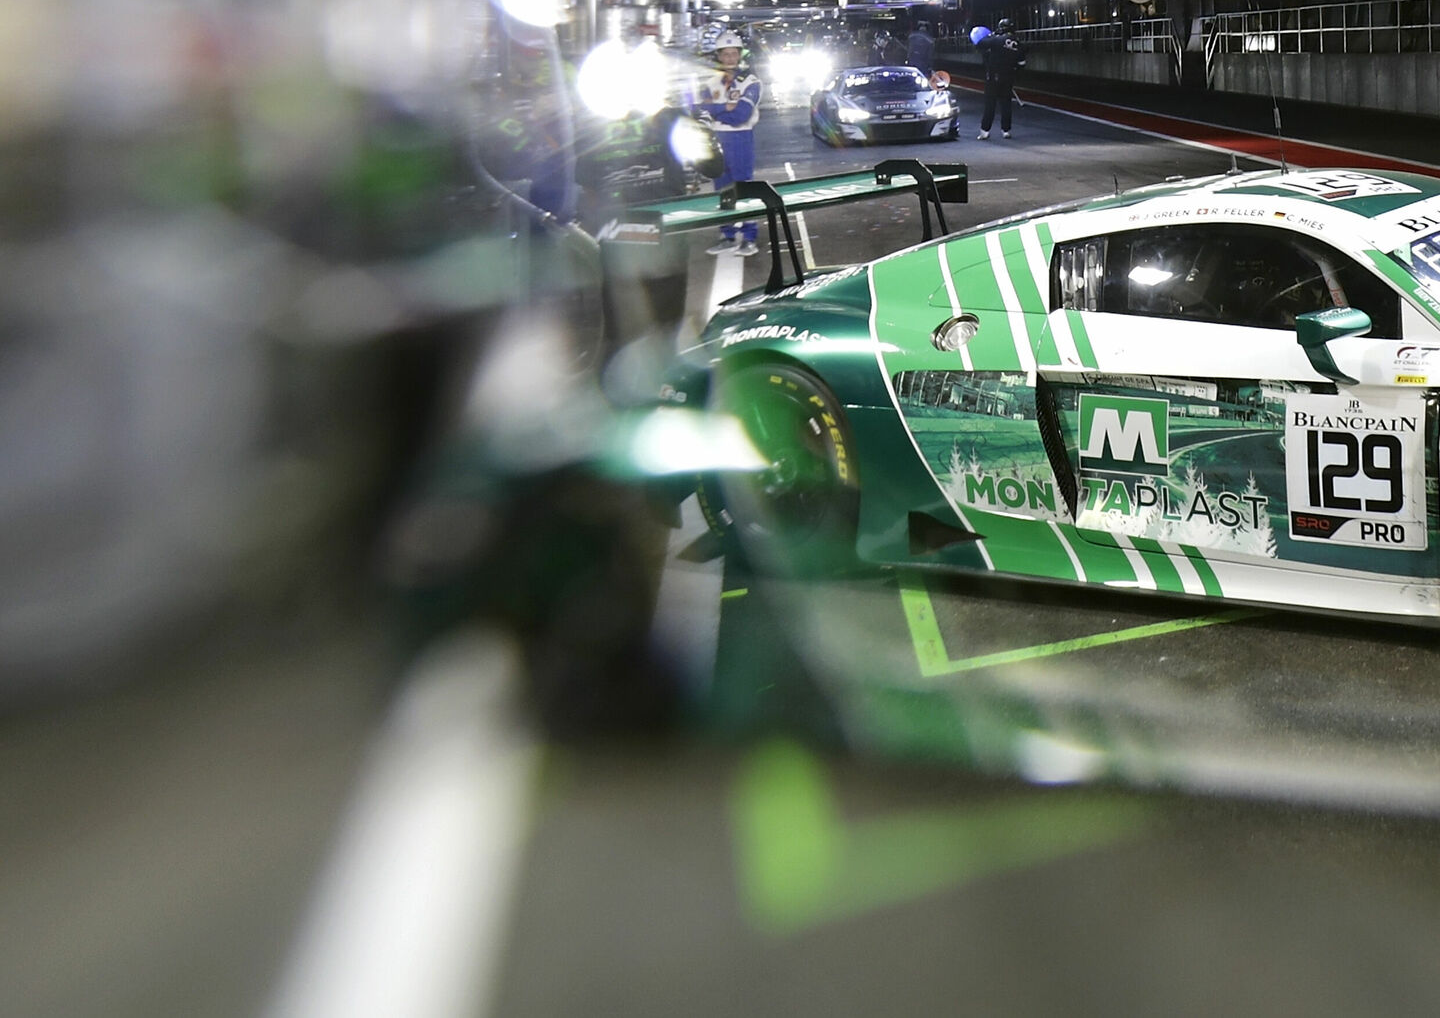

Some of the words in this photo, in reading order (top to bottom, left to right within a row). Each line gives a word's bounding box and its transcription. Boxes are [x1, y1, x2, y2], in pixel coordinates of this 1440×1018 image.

[1153, 210, 1190, 219] GREEN
[1224, 208, 1265, 217] FELLER
[1300, 218, 1325, 232] MIES
[1294, 411, 1418, 433] BLANCPAIN
[822, 412, 848, 481] ZERO
[1083, 408, 1166, 463] M
[1307, 430, 1404, 514] 129
[1296, 516, 1330, 531] SRO
[1361, 521, 1405, 544] PRO
